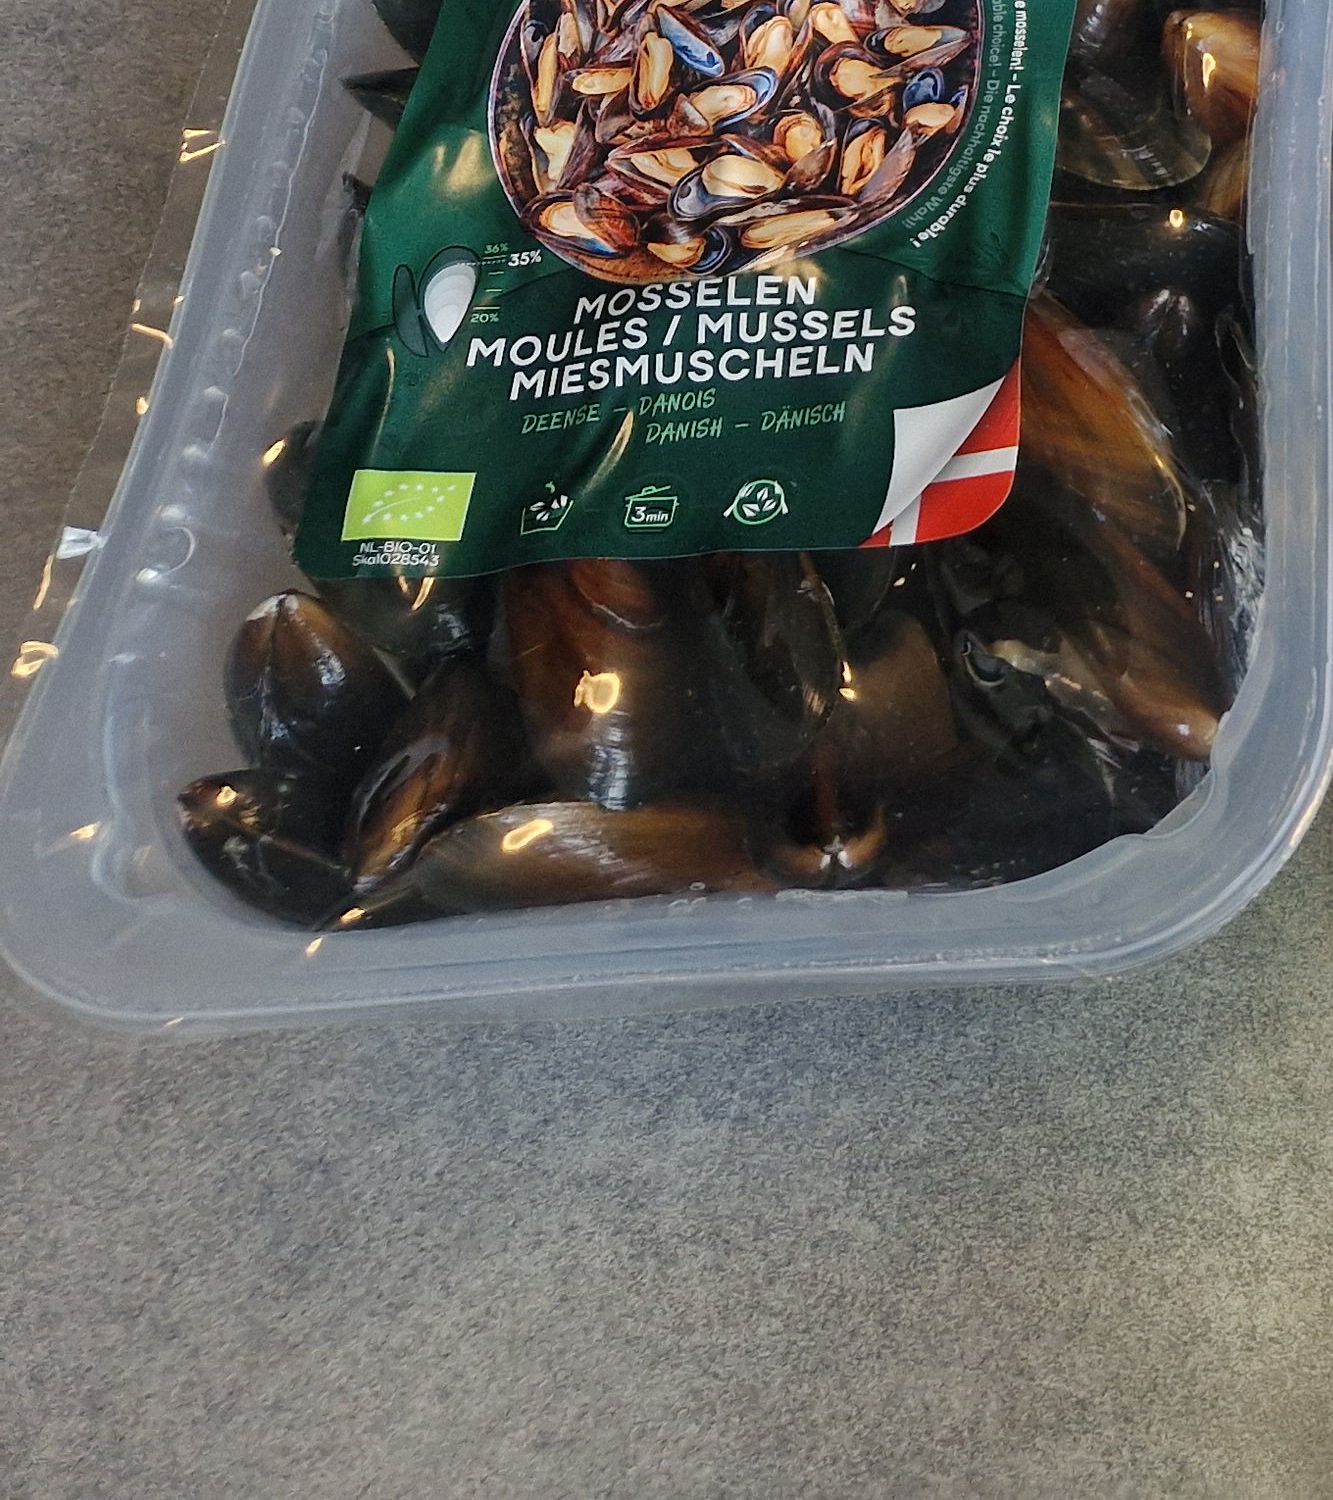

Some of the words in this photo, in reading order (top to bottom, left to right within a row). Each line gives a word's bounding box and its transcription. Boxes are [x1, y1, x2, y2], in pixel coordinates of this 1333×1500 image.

[1009, 9, 1029, 70] mosselen!
[1005, 84, 1022, 104] Le
[991, 106, 1015, 147] choix
[964, 162, 989, 193] plus
[918, 194, 967, 241] durable
[507, 249, 541, 267] 35%
[471, 313, 499, 324] 20%
[574, 276, 817, 324] MOSSELEN
[465, 318, 648, 367] MOULES
[698, 305, 917, 347] MUSSELS
[509, 342, 875, 400] MIESMUSCHELN
[521, 404, 600, 434] DEENSE
[639, 389, 716, 416] DANOIS
[645, 418, 723, 445] DANISH
[761, 401, 847, 436] DÄNISCH
[359, 541, 437, 556] NL-BIO-01
